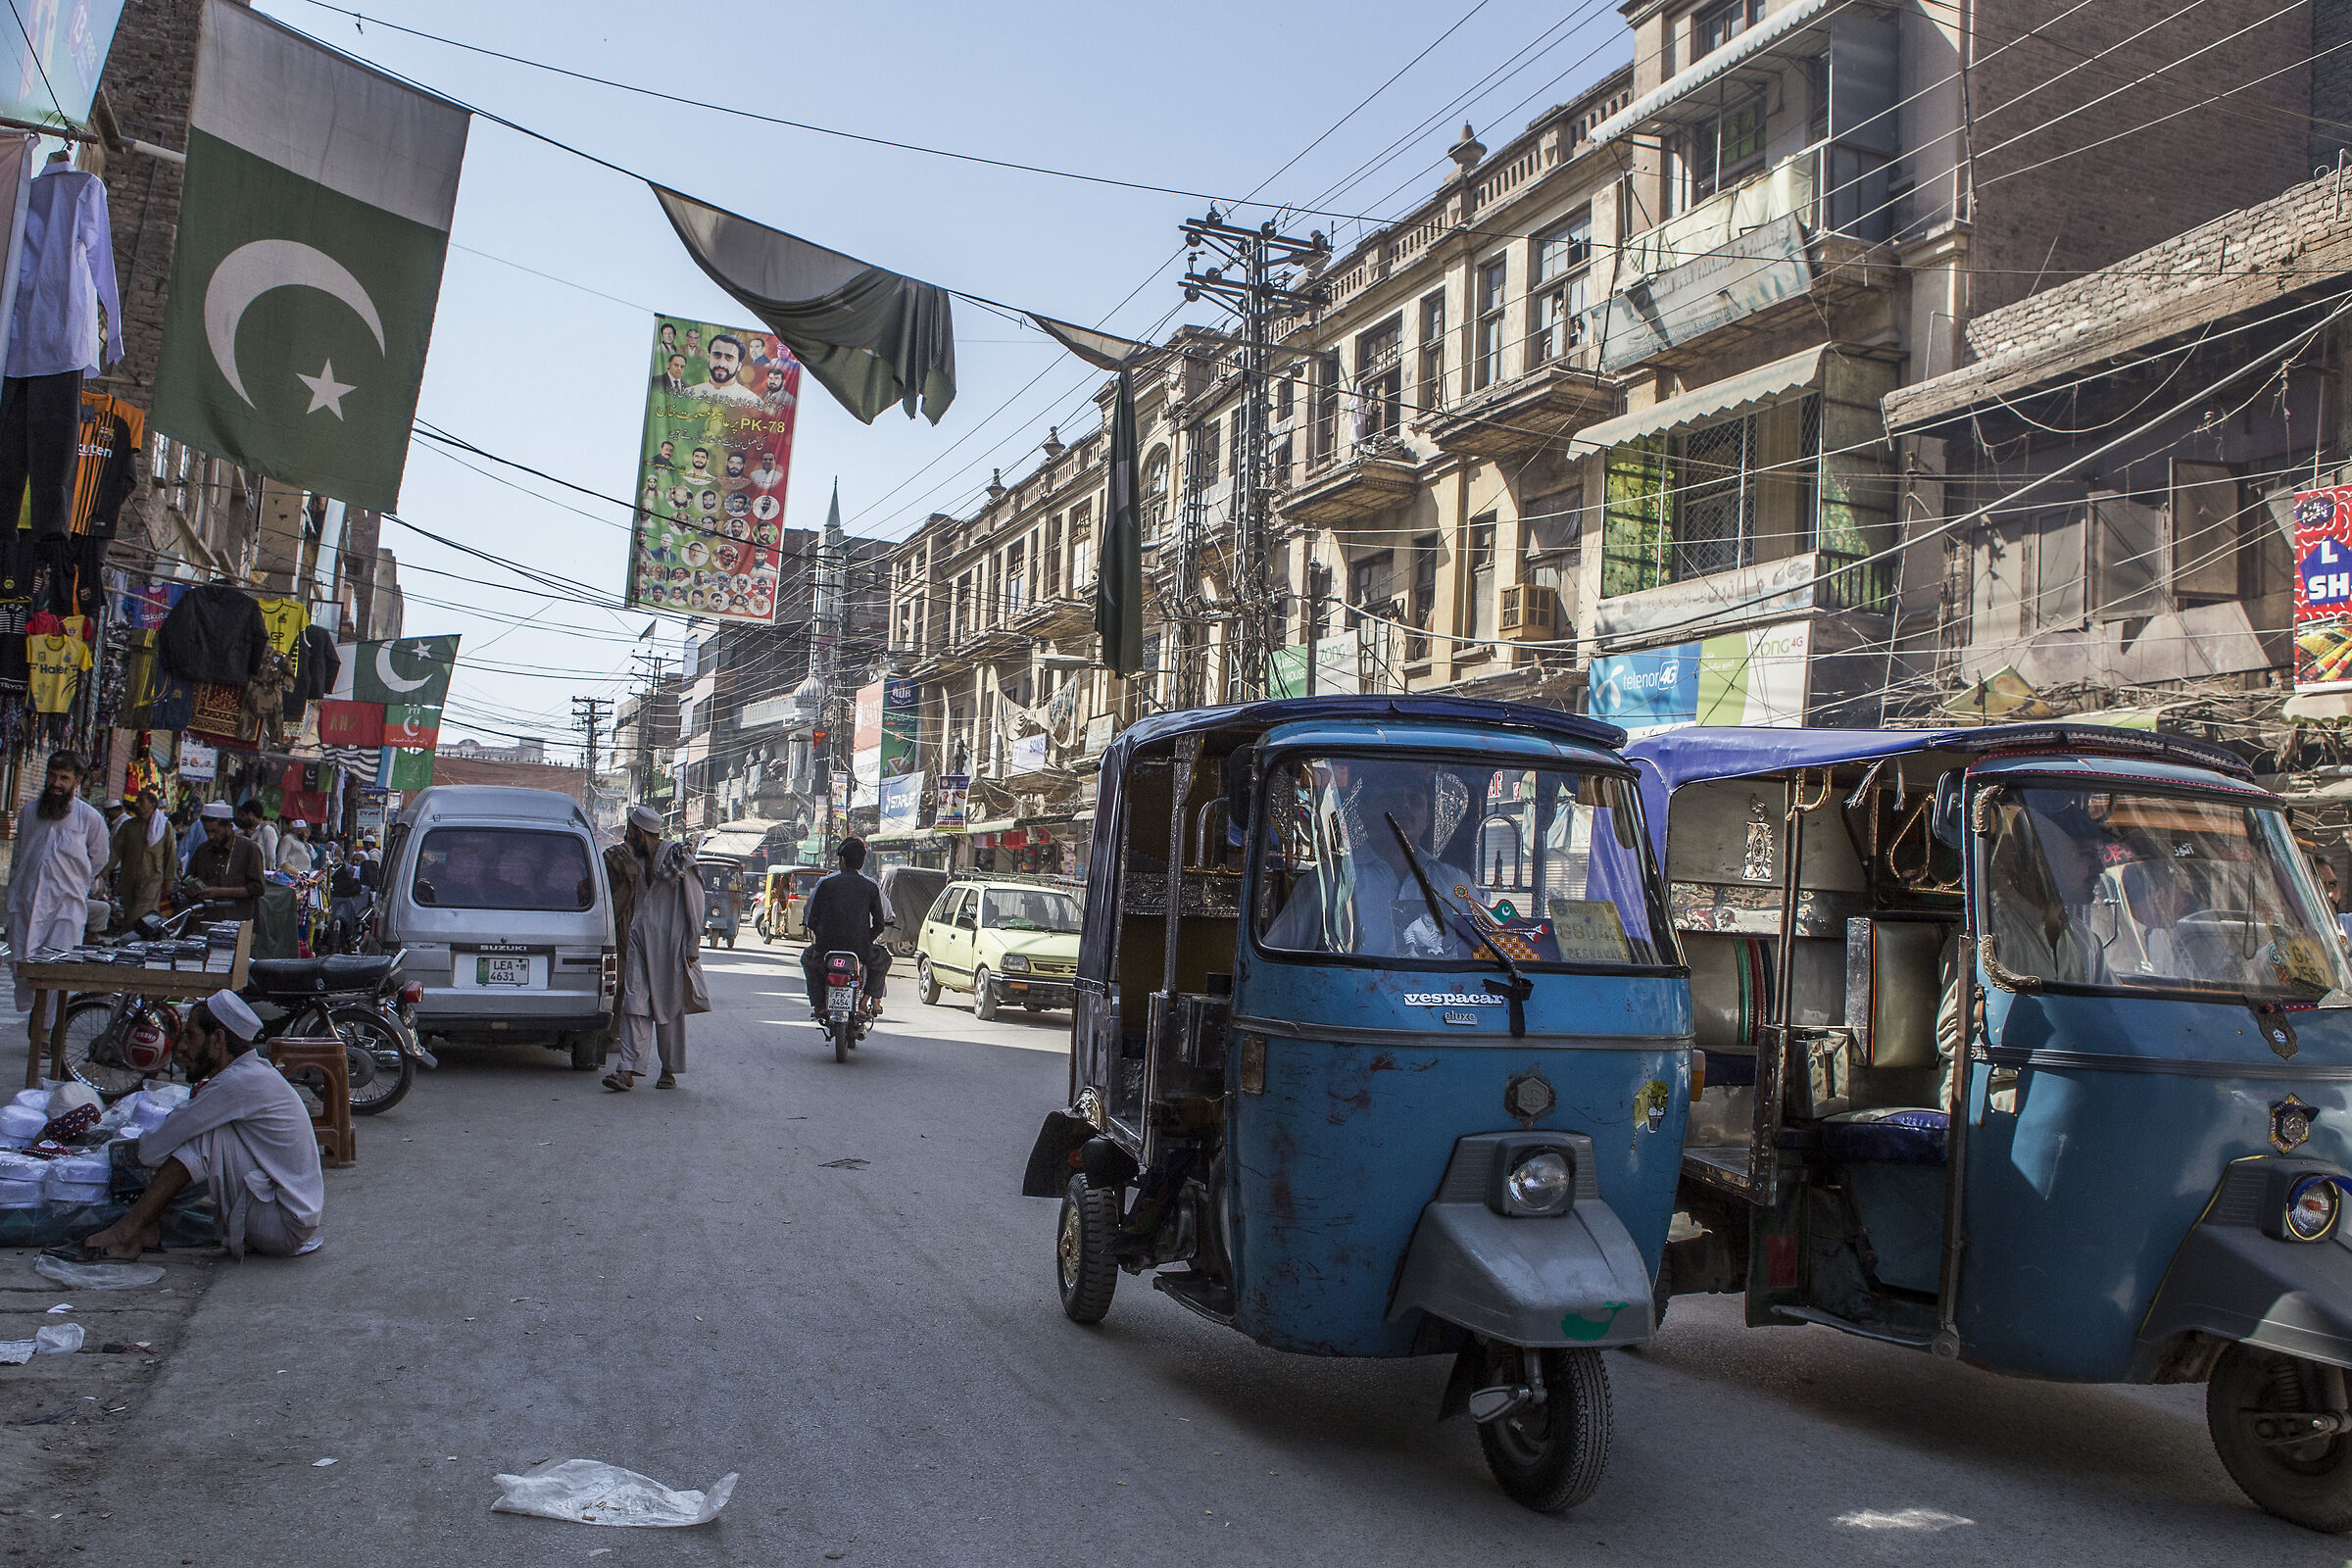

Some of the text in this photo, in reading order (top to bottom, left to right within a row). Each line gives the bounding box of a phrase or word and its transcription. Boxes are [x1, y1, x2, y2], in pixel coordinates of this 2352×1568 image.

[739, 417, 785, 433] PK-78
[78, 442, 113, 459] kuten
[1790, 636, 1803, 648] 4G
[40, 663, 69, 674] Haier
[1623, 665, 1677, 690] telenor 4G
[493, 960, 514, 971] LEA
[490, 971, 515, 982] 4631
[1403, 992, 1504, 1005] vespacar
[1444, 1010, 1476, 1021] eluxe
